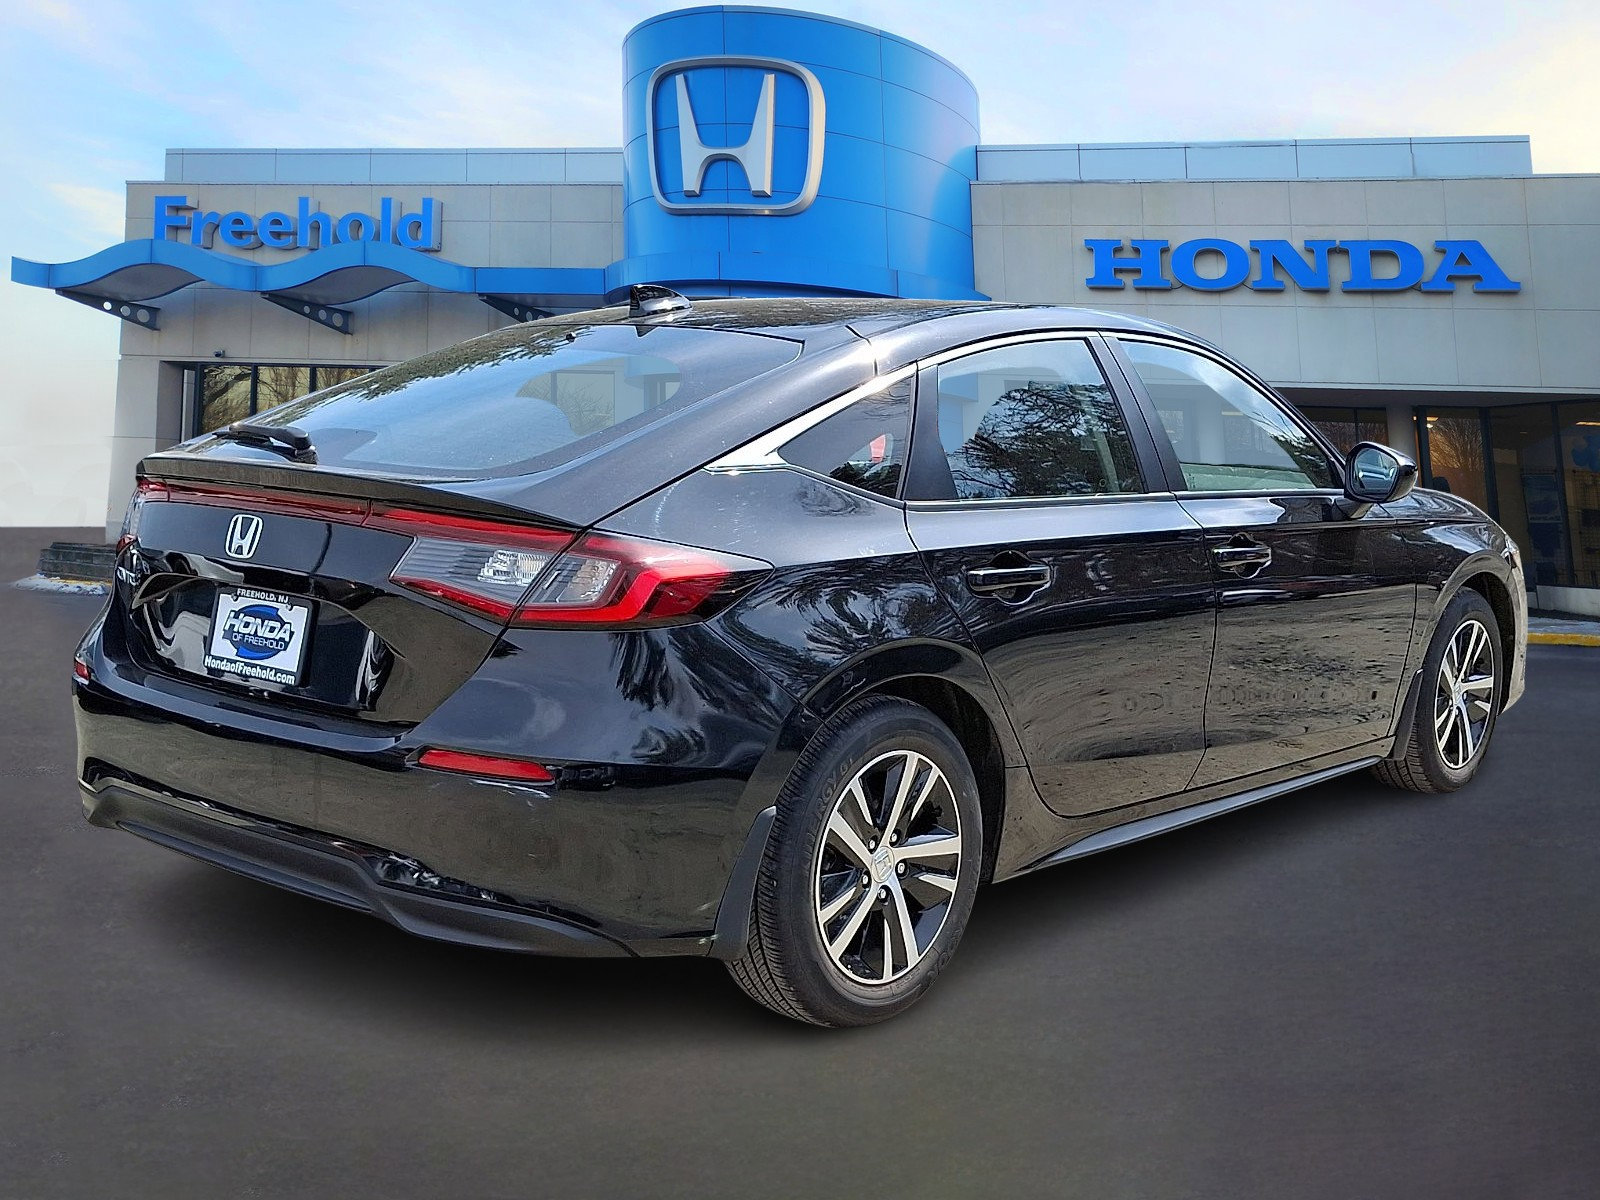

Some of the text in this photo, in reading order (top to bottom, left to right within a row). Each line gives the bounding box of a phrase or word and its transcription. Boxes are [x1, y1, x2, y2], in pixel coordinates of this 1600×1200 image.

[154, 195, 441, 250] Freehold
[1084, 238, 1521, 293] HONDA
[279, 594, 289, 604] NJ
[224, 611, 292, 642] HONDA
[232, 633, 285, 650] OF FREEHOLD
[204, 655, 296, 685] HondaofFreehold.com
